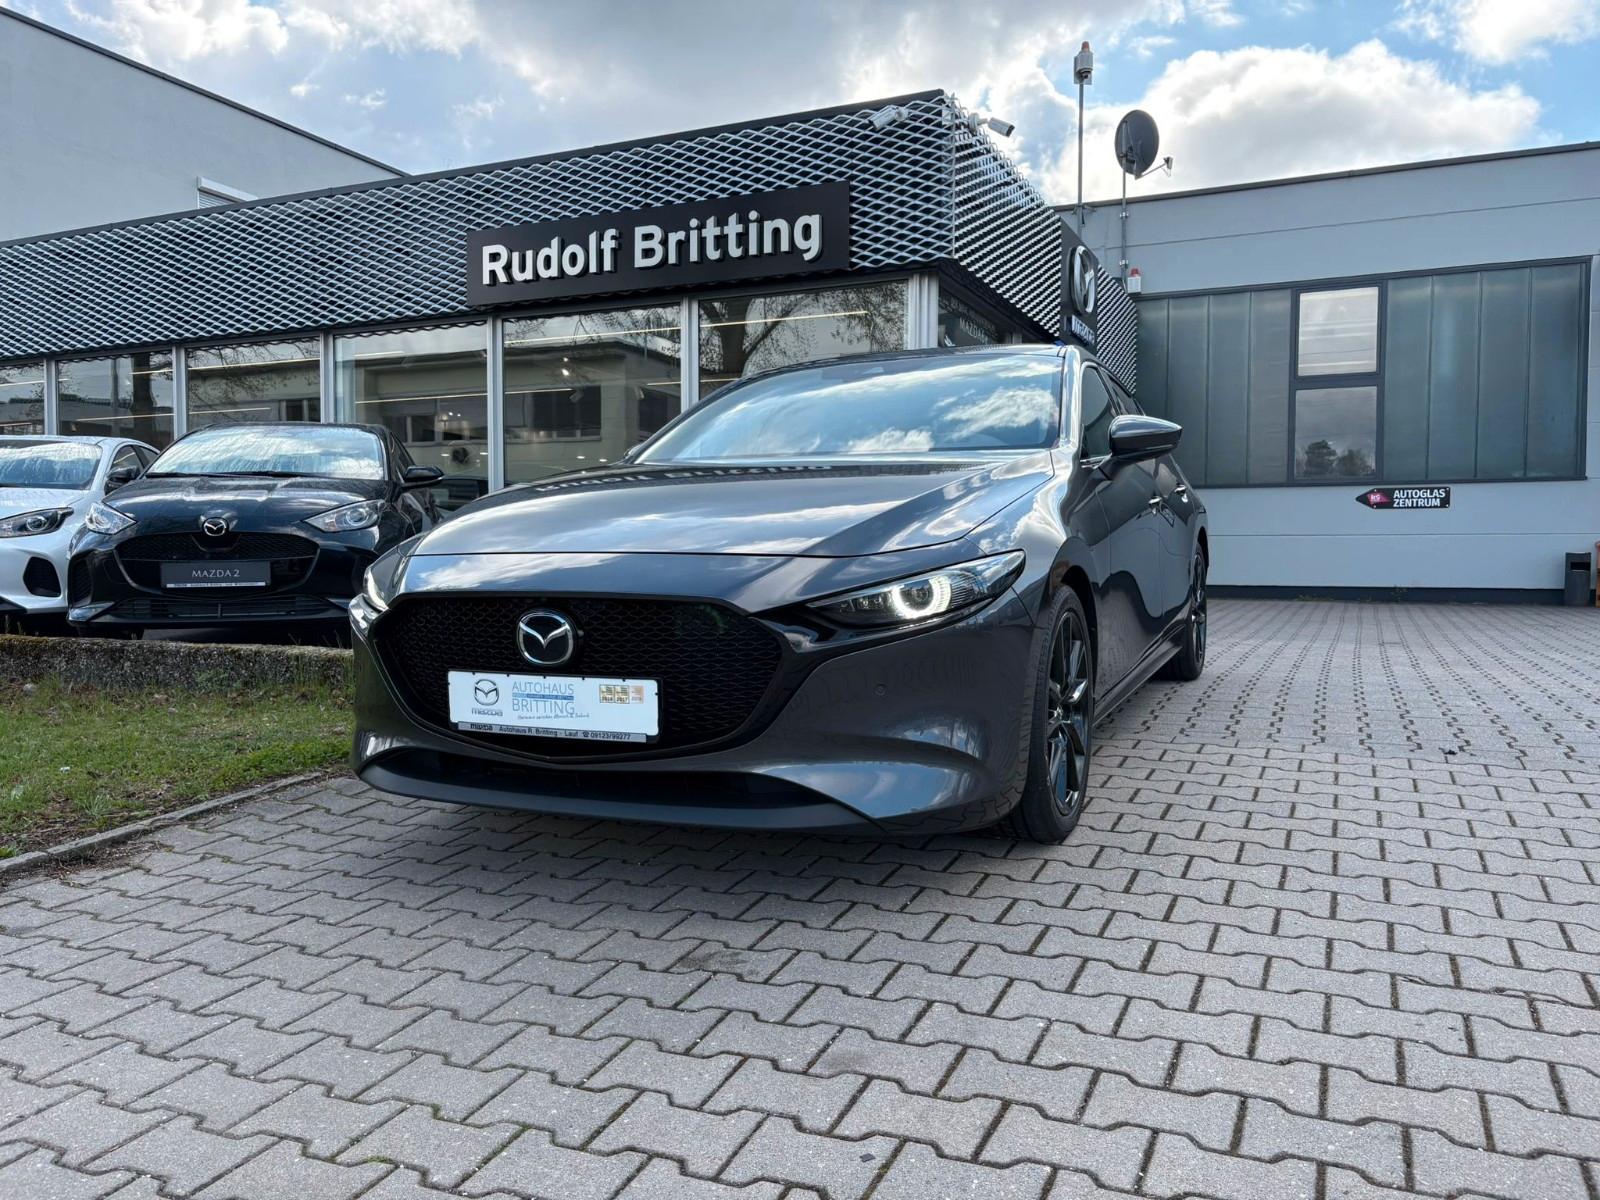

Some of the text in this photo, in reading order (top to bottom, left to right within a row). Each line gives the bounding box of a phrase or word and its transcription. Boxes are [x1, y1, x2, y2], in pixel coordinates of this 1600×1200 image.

[482, 210, 823, 285] Rudolf Britting
[1393, 489, 1446, 499] AUTOGLAS
[1393, 499, 1440, 508] ZENTRUM
[191, 569, 240, 578] MAZDA 2
[512, 681, 574, 695] AUTOHAUS
[512, 698, 575, 715] BRITTING
[499, 726, 527, 734] Autohaus
[535, 728, 558, 737] Britting
[565, 729, 579, 737] Lauf
